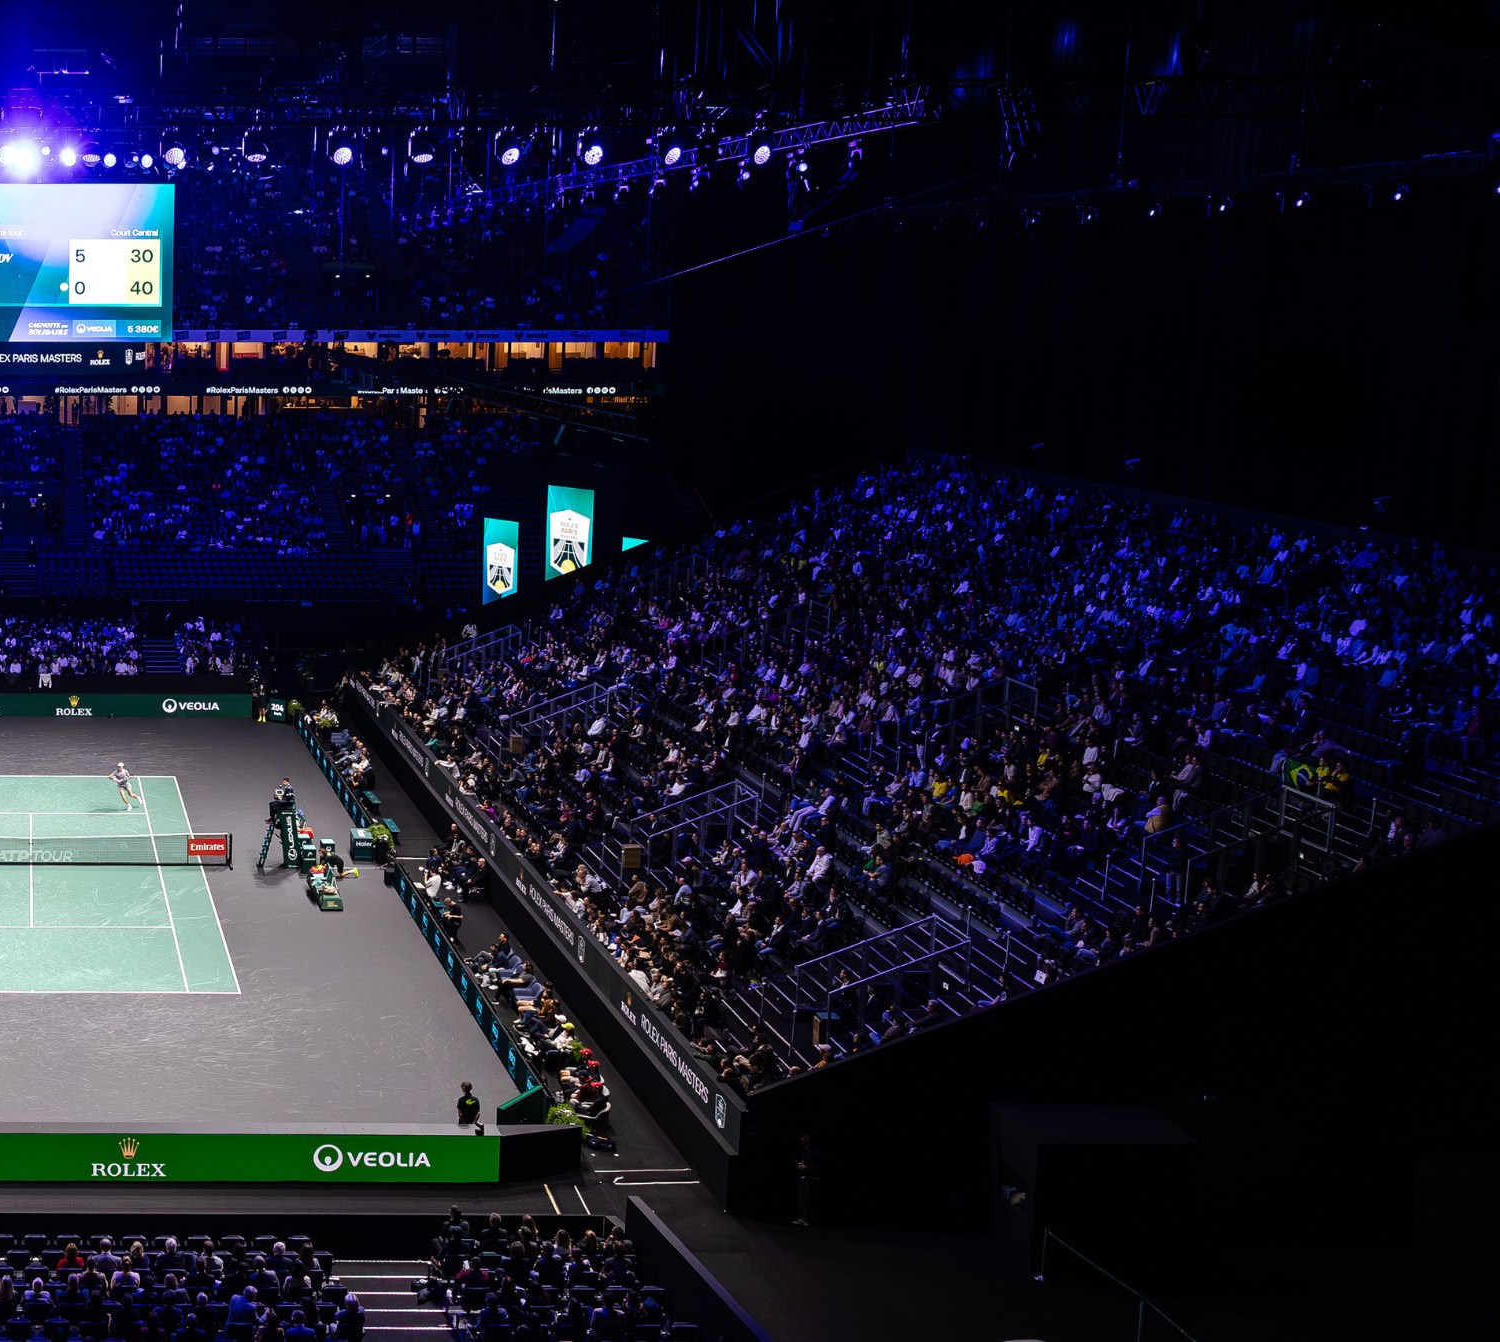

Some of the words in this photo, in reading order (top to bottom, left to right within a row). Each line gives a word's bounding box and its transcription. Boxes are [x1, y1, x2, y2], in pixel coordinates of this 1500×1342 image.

[110, 228, 130, 236] Court
[132, 228, 158, 236] Central
[75, 250, 86, 263] 5
[130, 249, 154, 263] 30
[75, 281, 86, 296] 0
[130, 281, 153, 295] 40
[12, 354, 39, 363] PARIS
[40, 354, 82, 363] MASTERS
[54, 386, 128, 394] #RolexParisMasters
[206, 386, 278, 394] #RolexParisMasters
[179, 702, 220, 711] VEOLIA
[271, 703, 284, 712] 204
[286, 816, 295, 849] LEXUS
[190, 843, 225, 851] Emirates
[32, 850, 74, 862] TOUR
[553, 912, 574, 946] MASTERS
[621, 1000, 637, 1026] ROLEX
[640, 1014, 660, 1047] ROLEX
[660, 1036, 678, 1067] PARIS
[678, 1056, 709, 1104] MASTERS
[347, 1152, 431, 1168] VEOLIA
[91, 1163, 166, 1177] ROLEX
